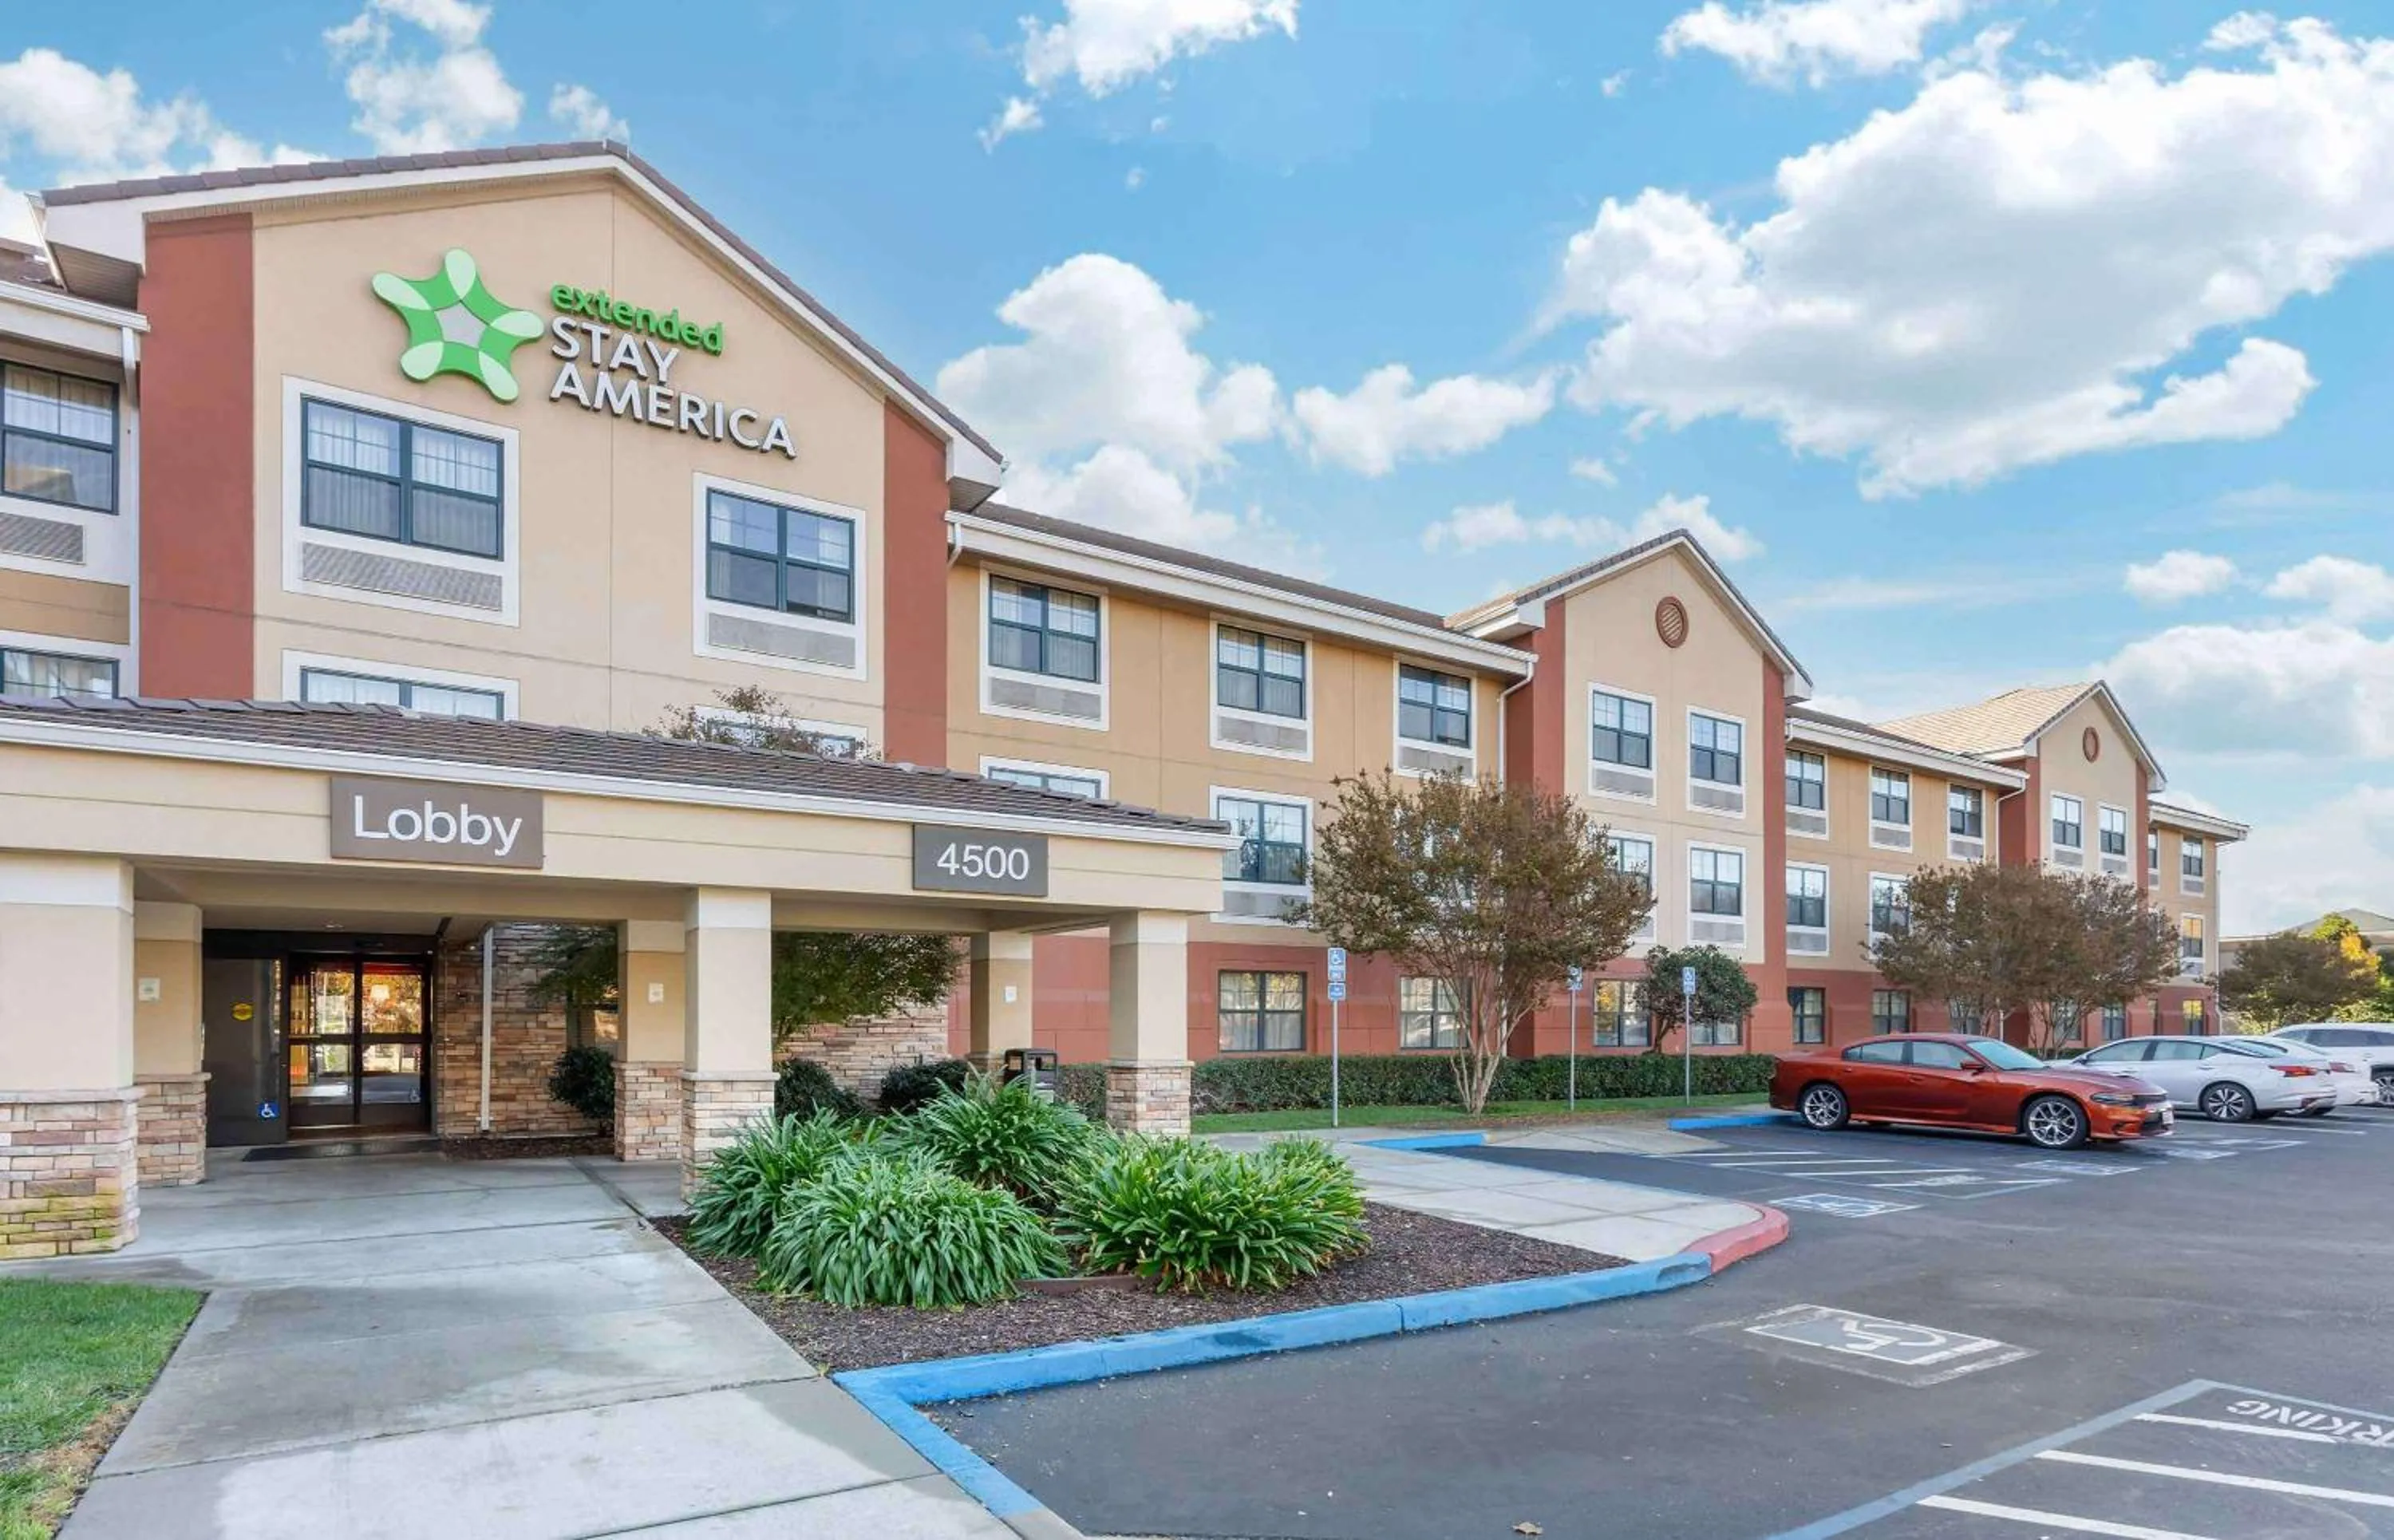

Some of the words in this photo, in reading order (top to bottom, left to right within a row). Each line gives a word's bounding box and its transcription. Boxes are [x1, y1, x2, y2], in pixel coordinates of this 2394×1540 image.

[550, 282, 723, 356] extended
[551, 317, 679, 384] STAY
[550, 361, 796, 459] AMERICA
[354, 796, 523, 856] Lobby
[936, 843, 1029, 880] 4500
